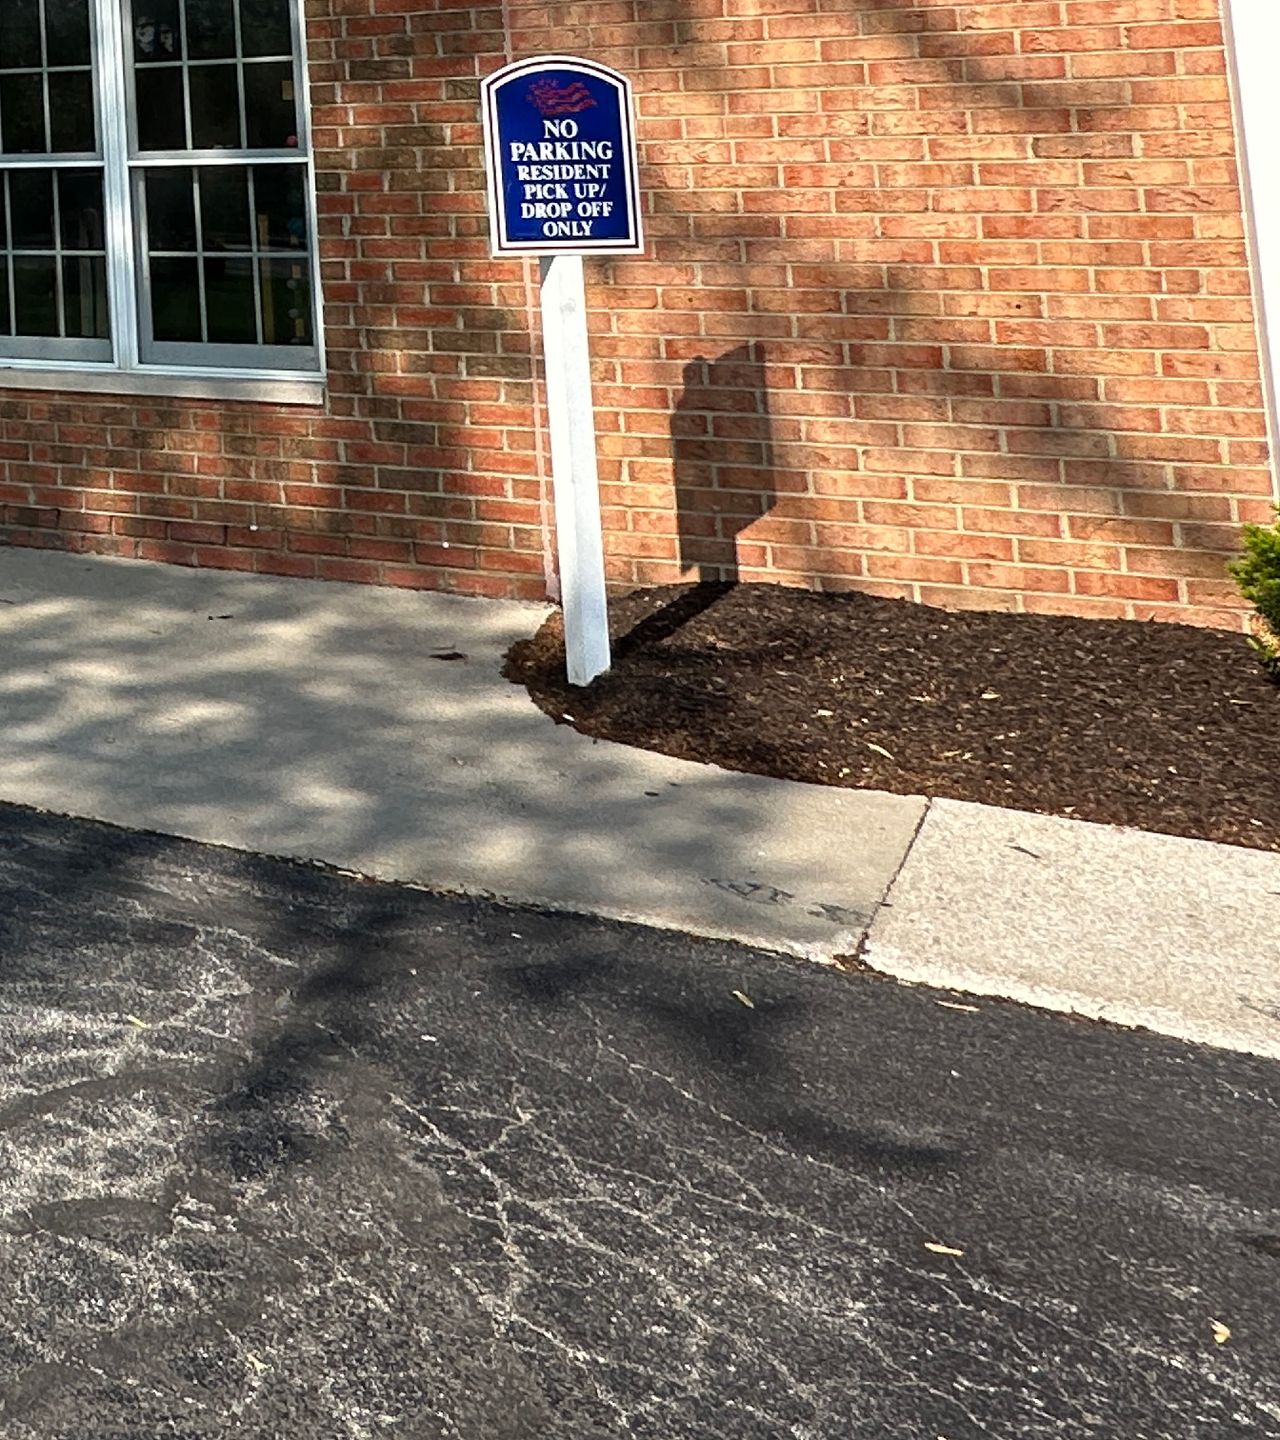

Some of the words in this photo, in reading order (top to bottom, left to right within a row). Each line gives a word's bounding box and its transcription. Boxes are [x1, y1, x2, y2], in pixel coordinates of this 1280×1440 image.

[543, 119, 578, 139] NO
[509, 141, 613, 162] PARKING
[517, 164, 611, 181] RESIDENT
[524, 183, 569, 200] PICK
[574, 183, 606, 198] UP/
[521, 202, 573, 219] DROP
[577, 201, 613, 217] OFF
[543, 220, 594, 237] ONLY
